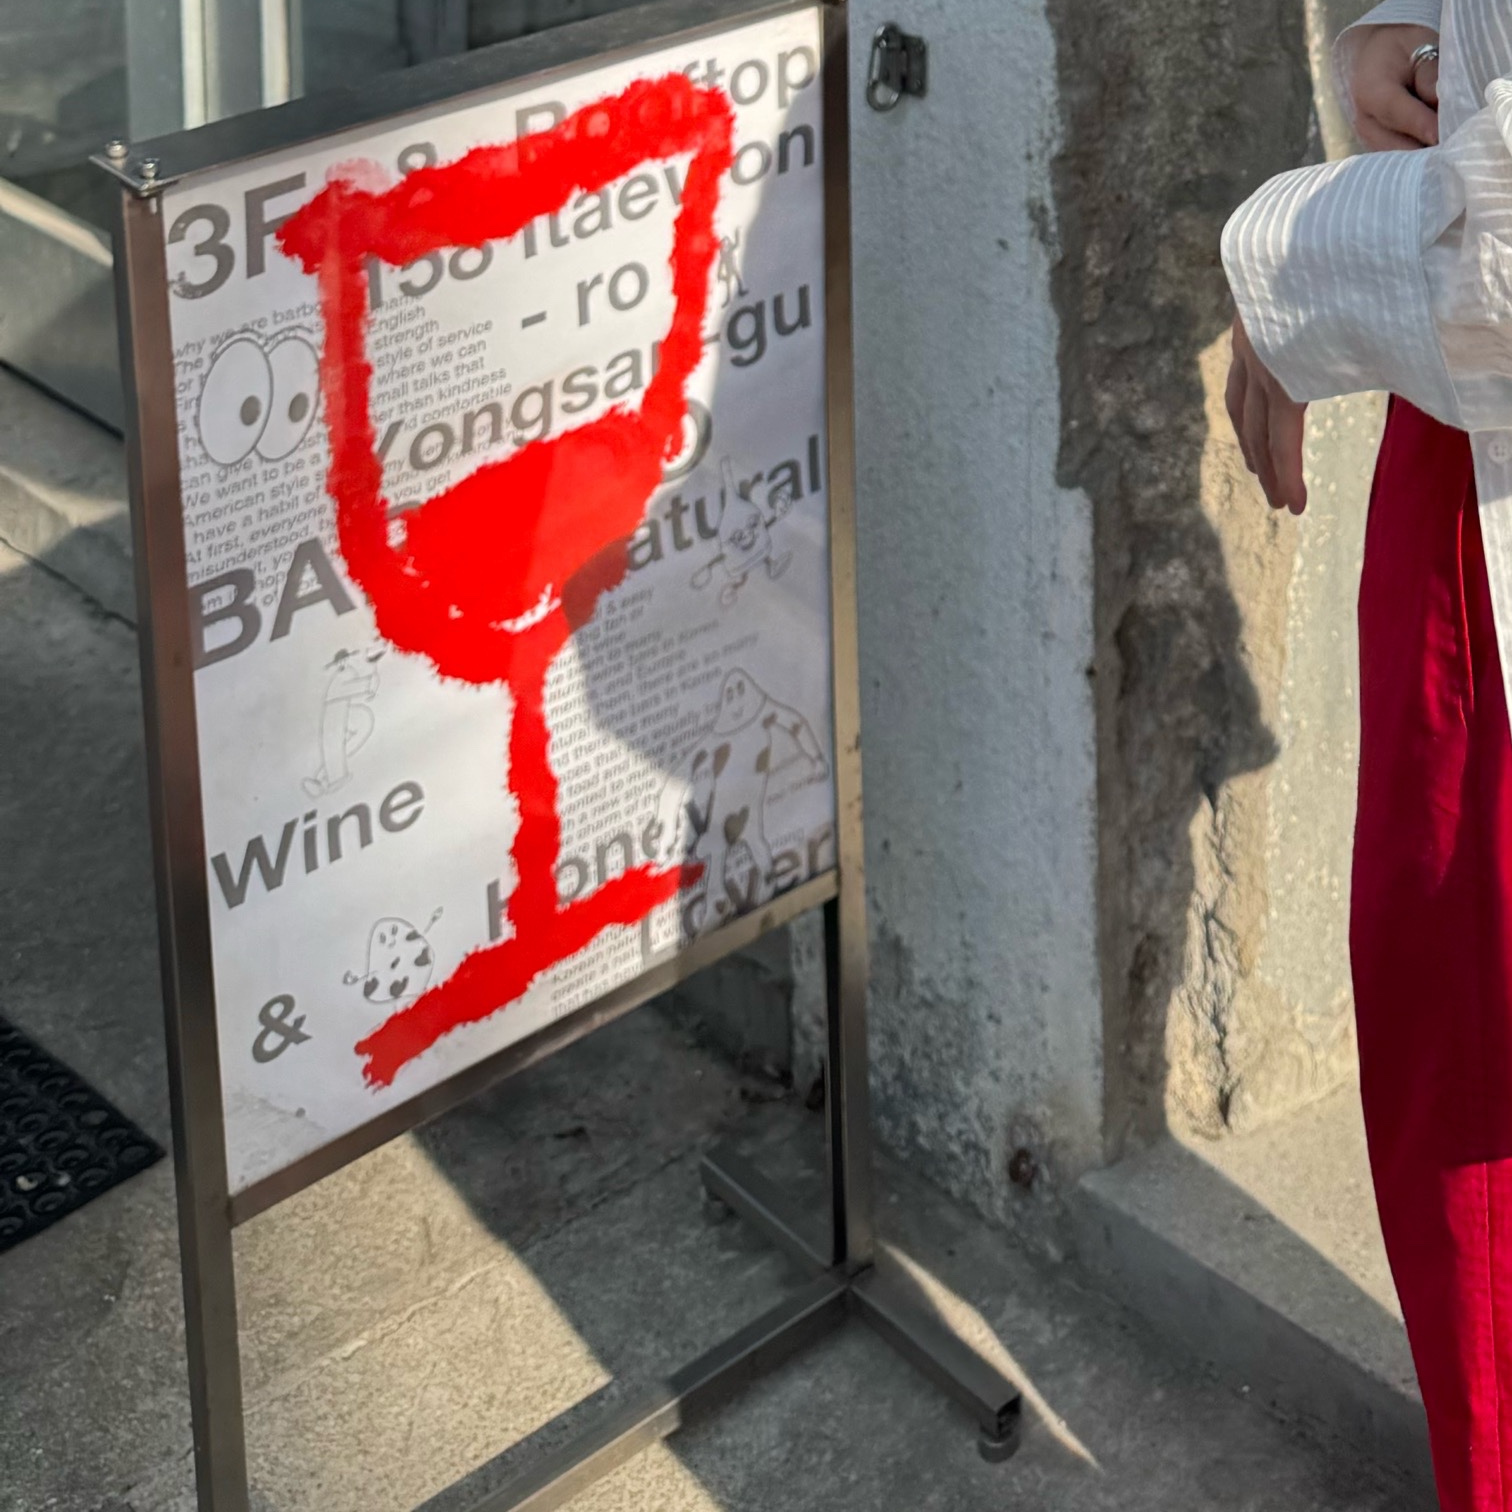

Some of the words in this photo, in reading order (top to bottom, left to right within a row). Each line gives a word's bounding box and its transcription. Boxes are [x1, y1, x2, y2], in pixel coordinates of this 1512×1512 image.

[577, 261, 649, 327] ro
[210, 780, 426, 910] Wine
[251, 993, 313, 1064] &
